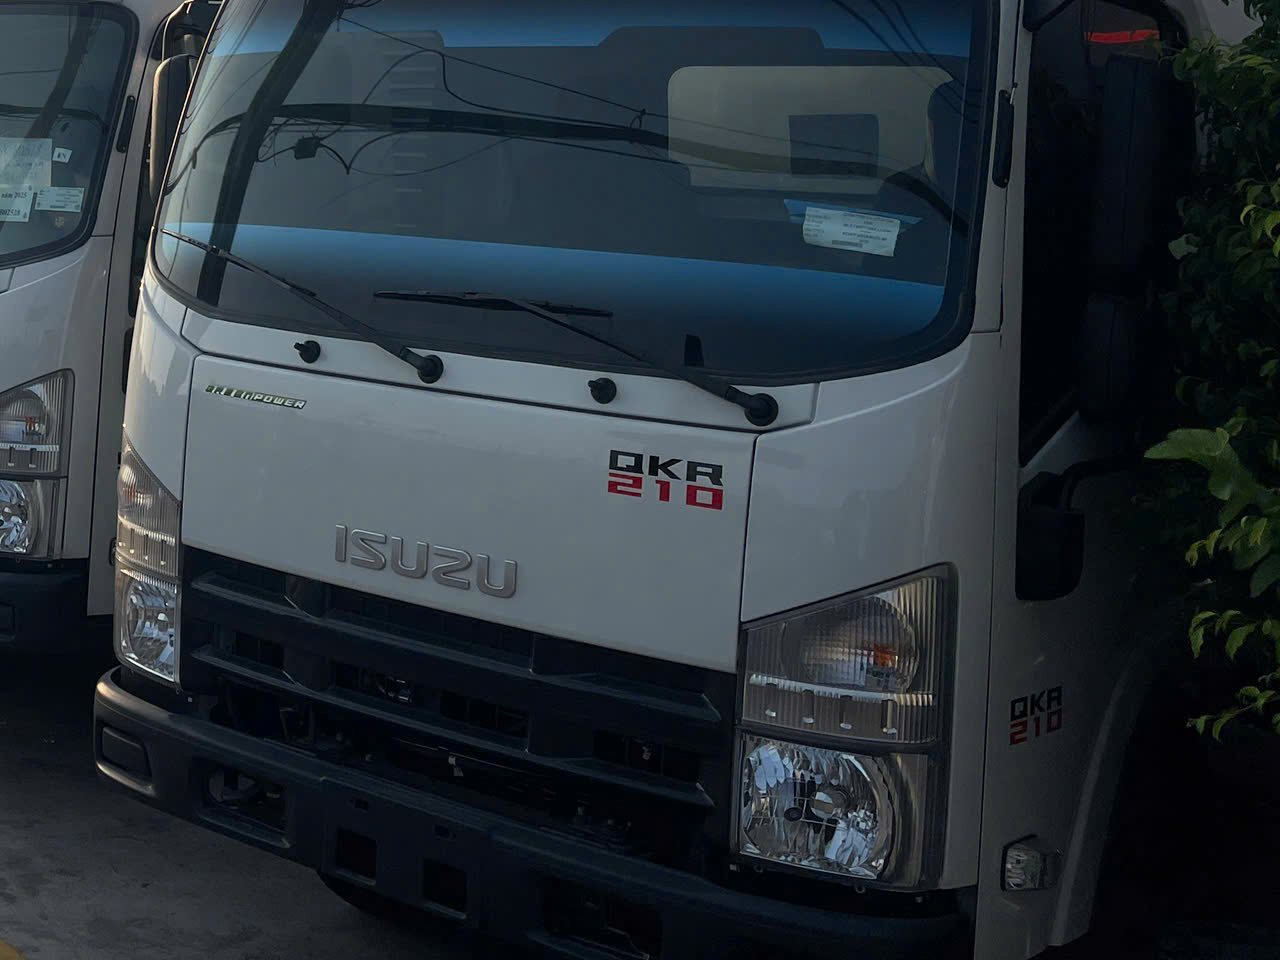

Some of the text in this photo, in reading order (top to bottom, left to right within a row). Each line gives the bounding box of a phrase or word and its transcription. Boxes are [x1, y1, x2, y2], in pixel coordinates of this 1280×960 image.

[609, 449, 724, 486] QKR
[608, 472, 724, 510] 210
[335, 524, 517, 599] ISUZU
[1010, 686, 1063, 721] QKR
[1009, 708, 1062, 746] 210
